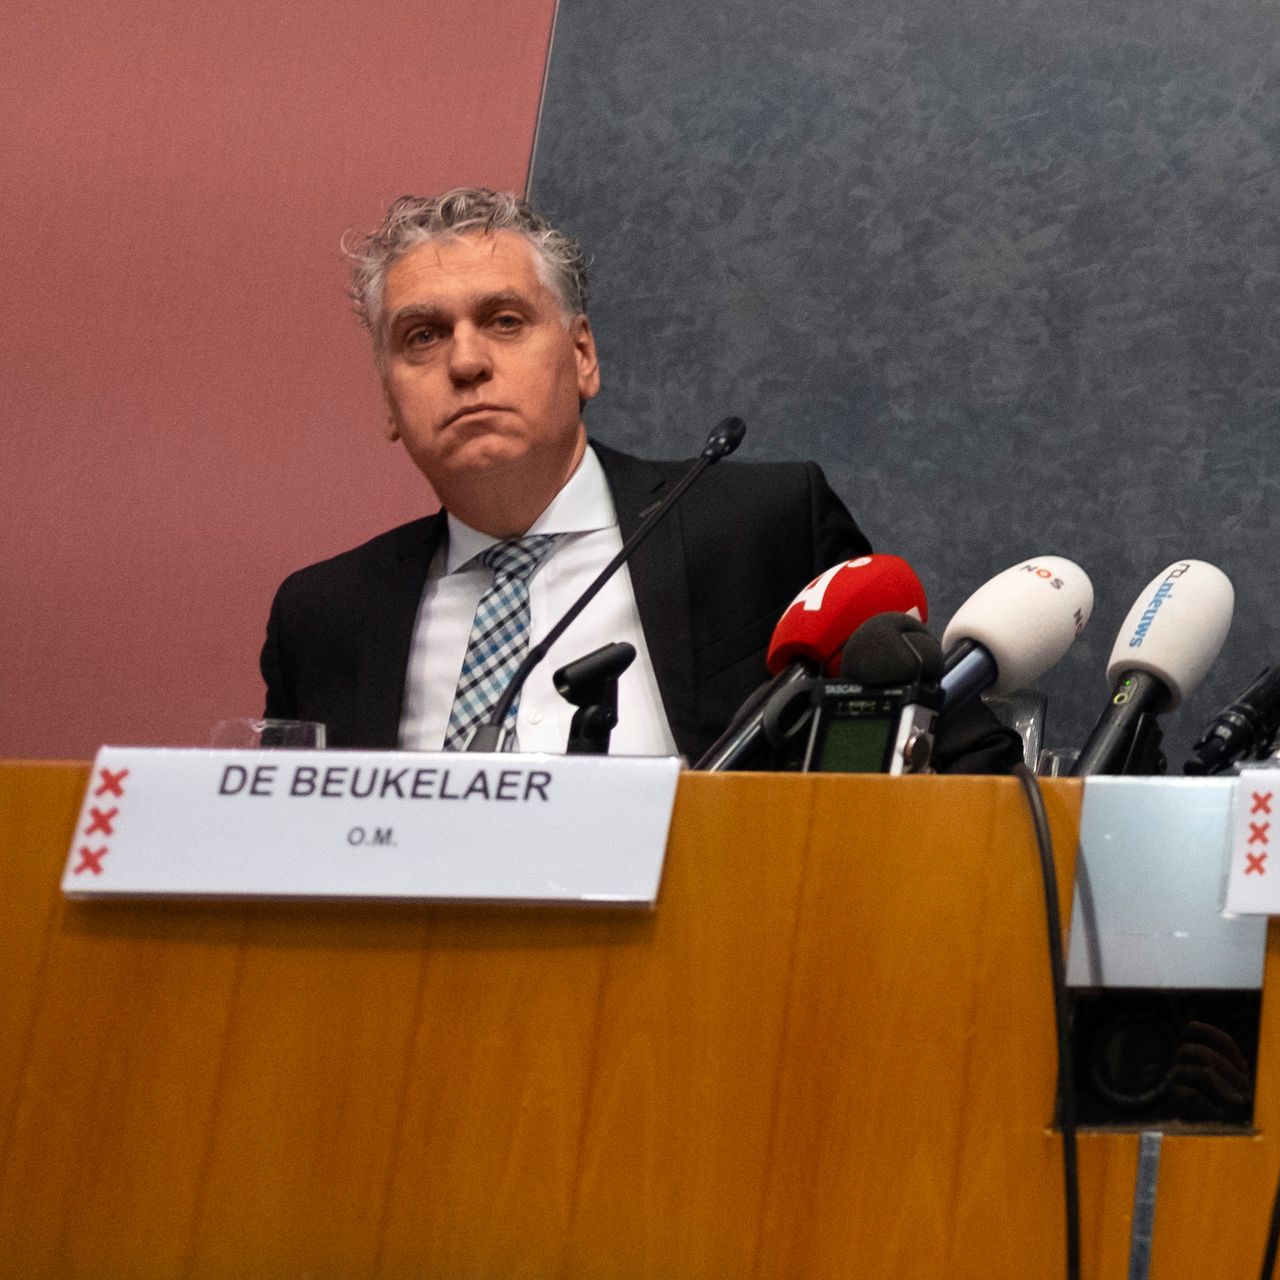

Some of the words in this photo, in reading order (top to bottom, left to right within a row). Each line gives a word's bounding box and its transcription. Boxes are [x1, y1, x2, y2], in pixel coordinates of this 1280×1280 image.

[1020, 564, 1065, 591] NOS
[1129, 581, 1175, 648] nieuws
[218, 765, 277, 796] DE
[289, 766, 552, 802] BEUKELAER
[347, 826, 399, 847] O.M.
